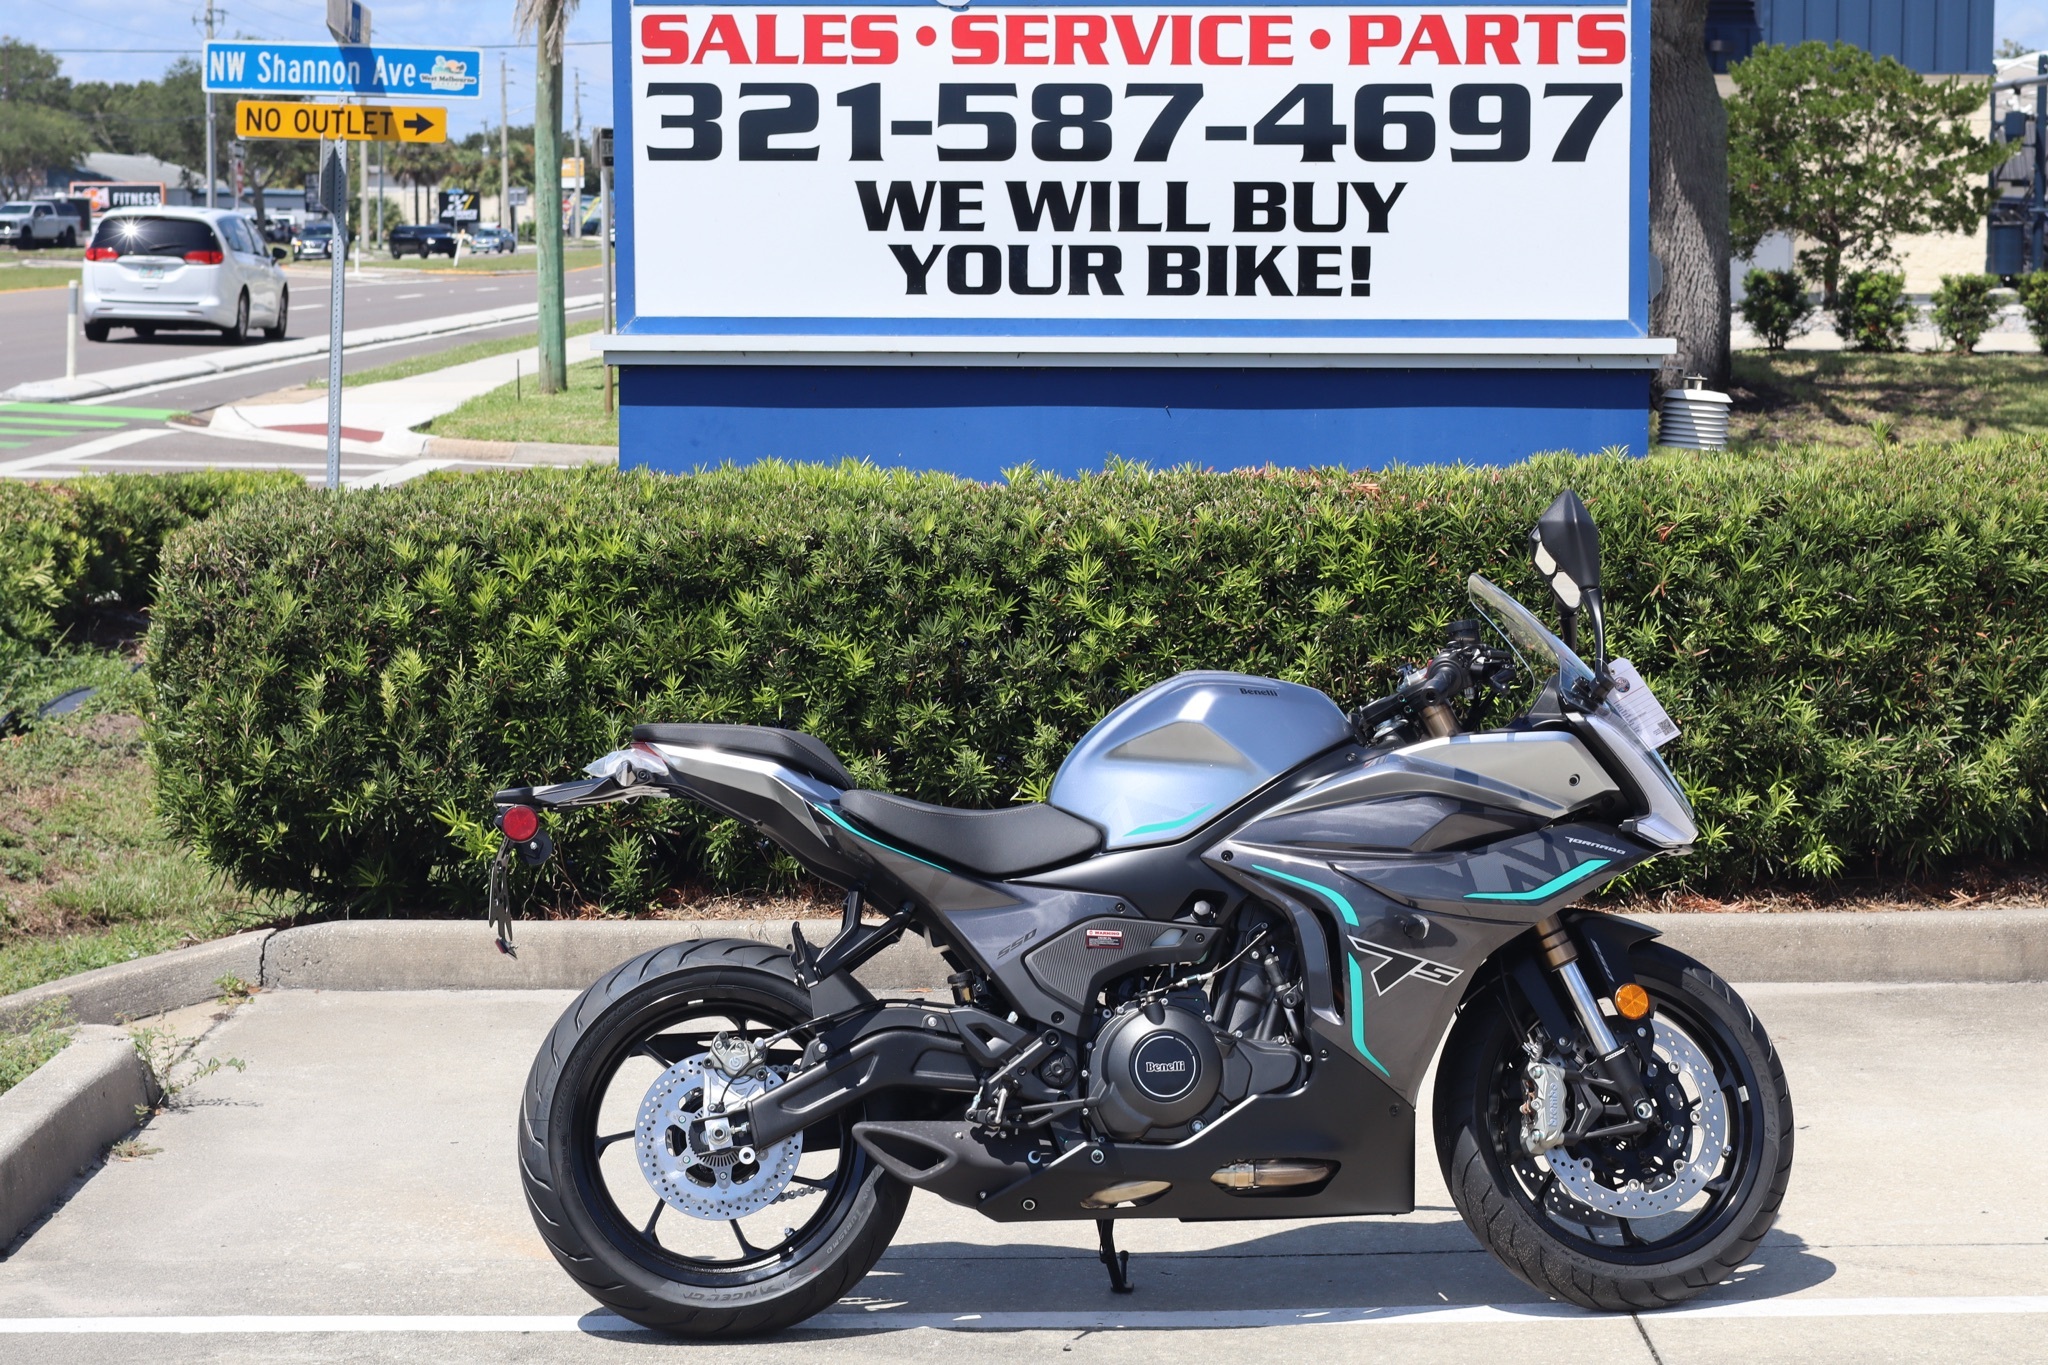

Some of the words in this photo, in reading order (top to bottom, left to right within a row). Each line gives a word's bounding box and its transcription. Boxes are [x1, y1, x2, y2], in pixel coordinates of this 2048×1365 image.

[641, 14, 898, 65] SALES
[951, 14, 1294, 66] SERVICE
[1348, 14, 1626, 66] PARTS
[210, 50, 246, 82] NW
[257, 51, 360, 84] Shannon
[373, 55, 417, 87] Ave
[246, 107, 281, 132] NO
[294, 111, 393, 136] OUTLET
[646, 82, 1624, 162] 321-587-4697
[113, 192, 160, 205] FITNESS
[855, 181, 985, 231] WE
[1005, 181, 1211, 232] WILL
[1232, 181, 1408, 233] BUY
[887, 244, 1125, 295] YOUR
[1146, 245, 1371, 297] BIKE!
[1239, 687, 1279, 697] Benelli
[1565, 836, 1626, 855] TORNADO
[997, 928, 1037, 960] 550
[1145, 1060, 1186, 1073] Benelli
